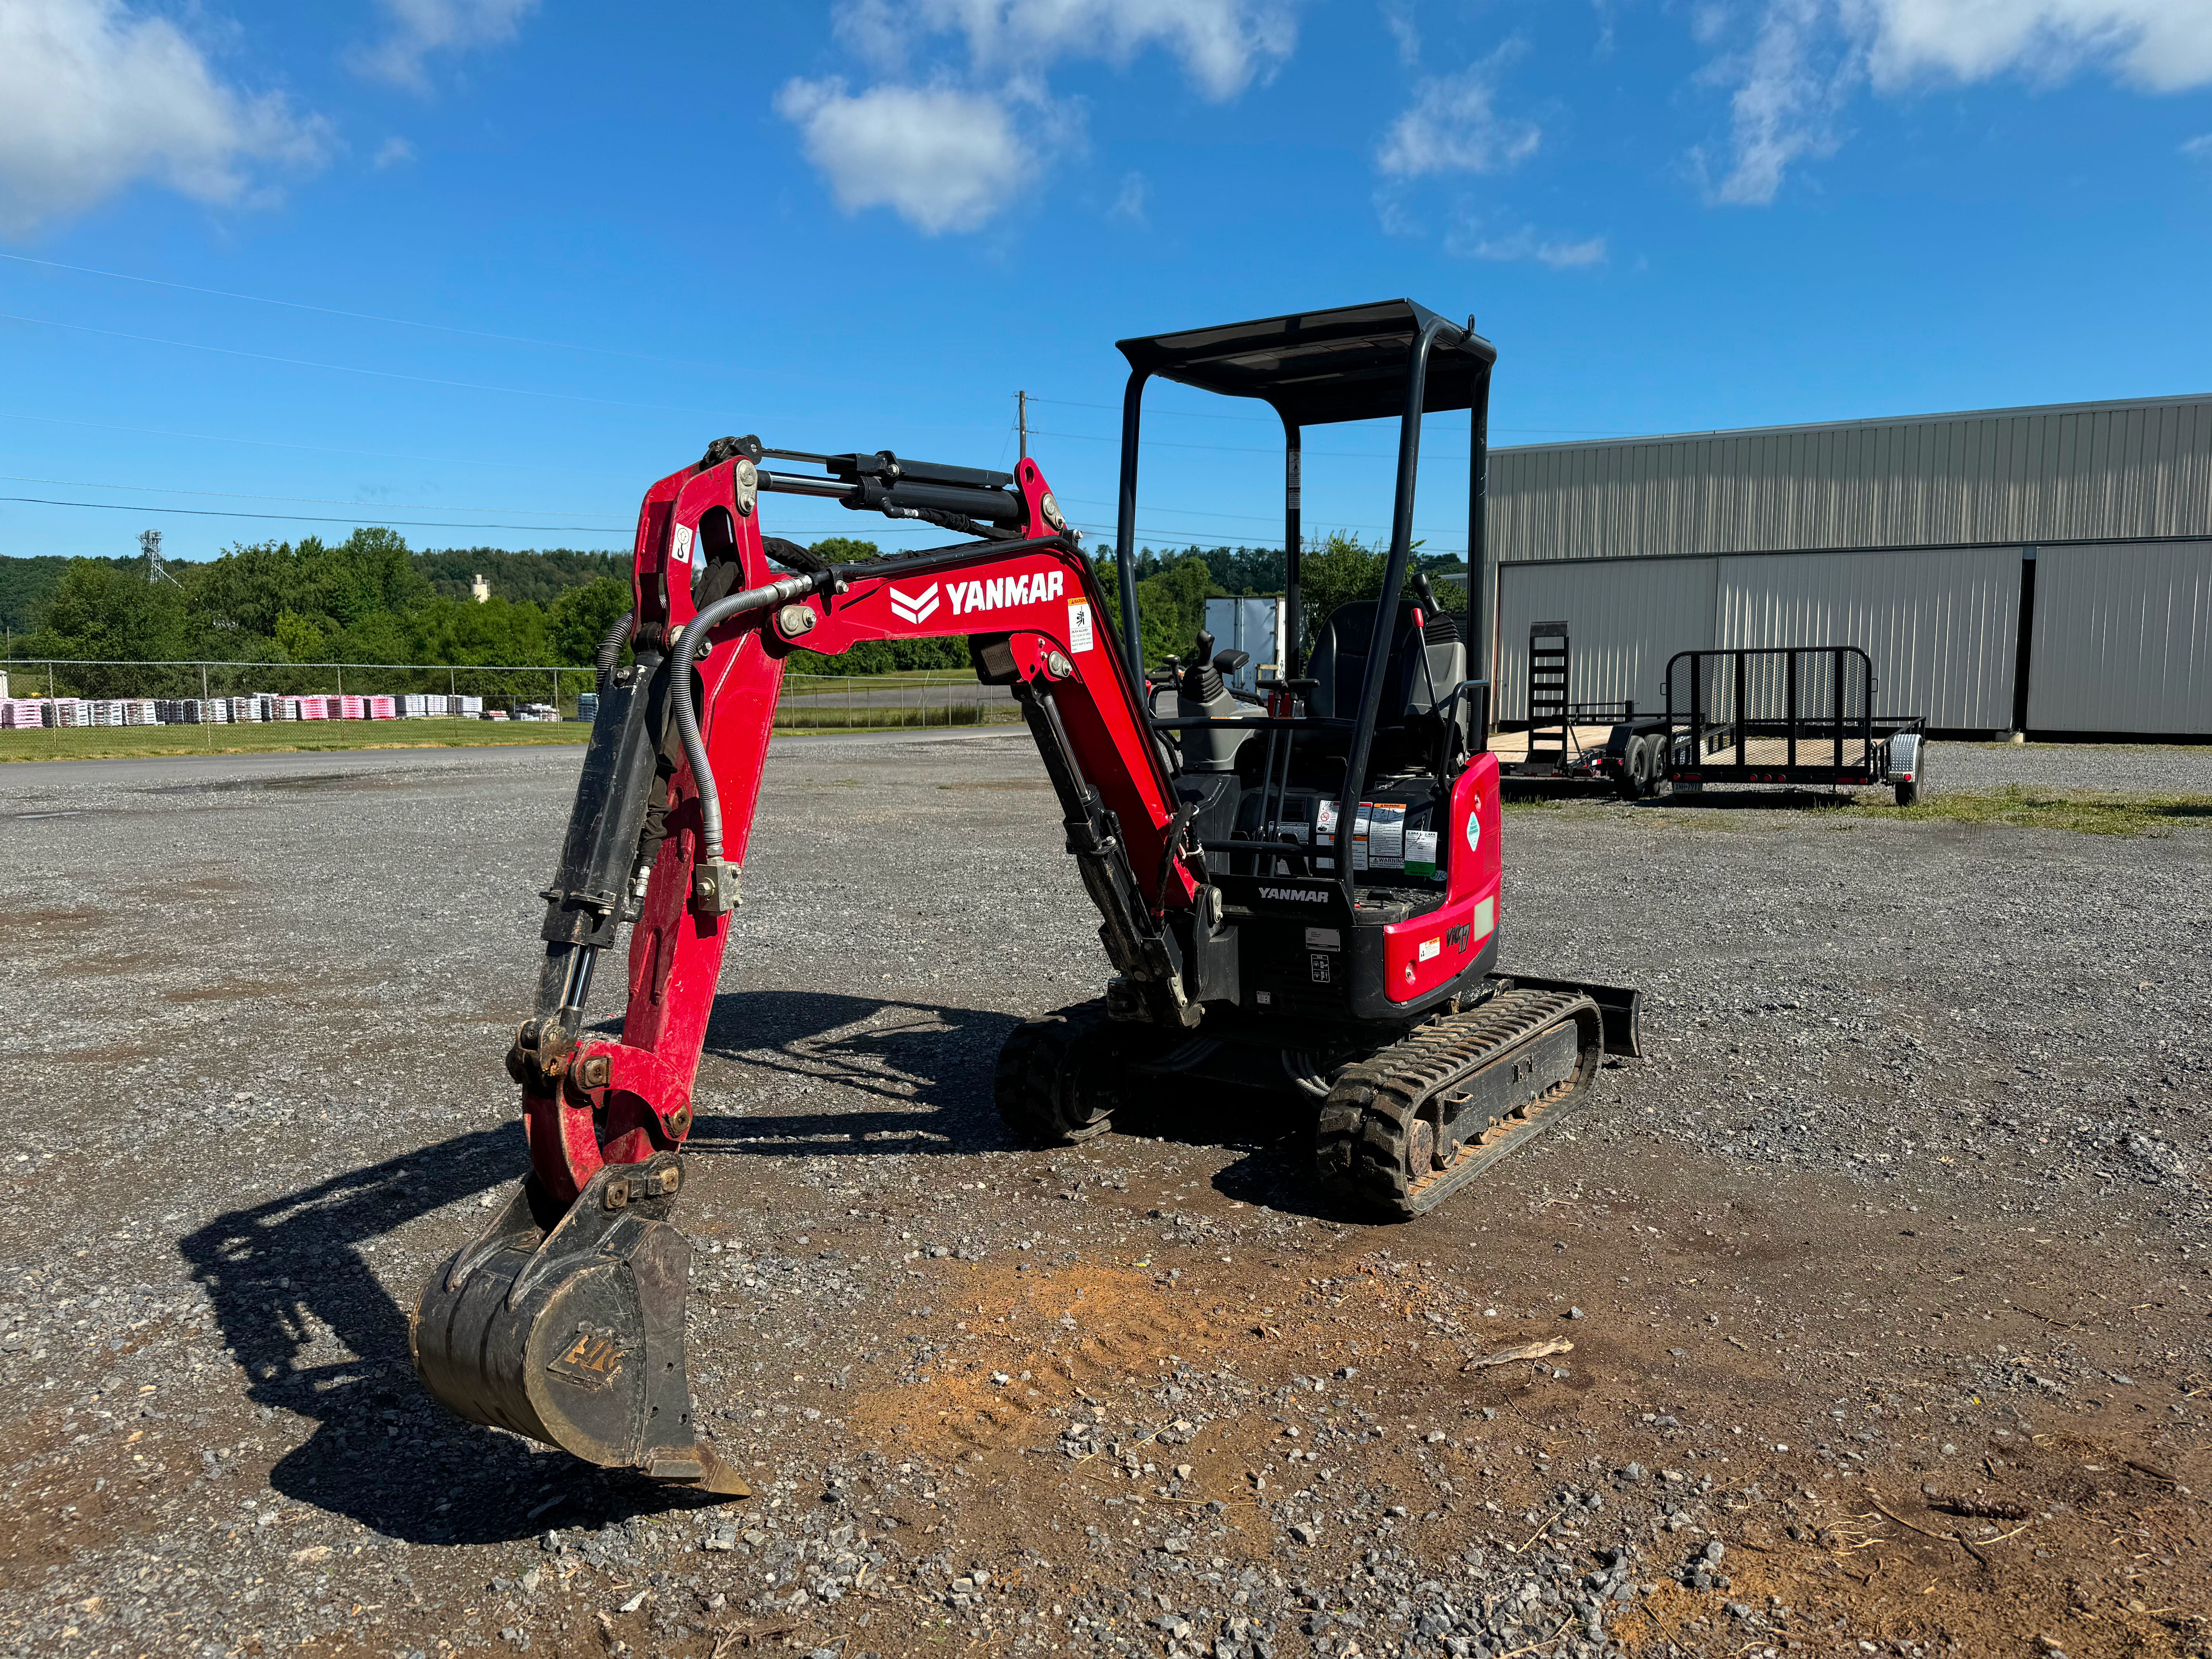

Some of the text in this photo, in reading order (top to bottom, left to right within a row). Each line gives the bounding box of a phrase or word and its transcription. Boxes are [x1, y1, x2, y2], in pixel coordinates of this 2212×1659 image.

[945, 570, 1063, 615] YANMAR
[1432, 871, 1446, 879] OK
[1259, 887, 1329, 903] YANMAR
